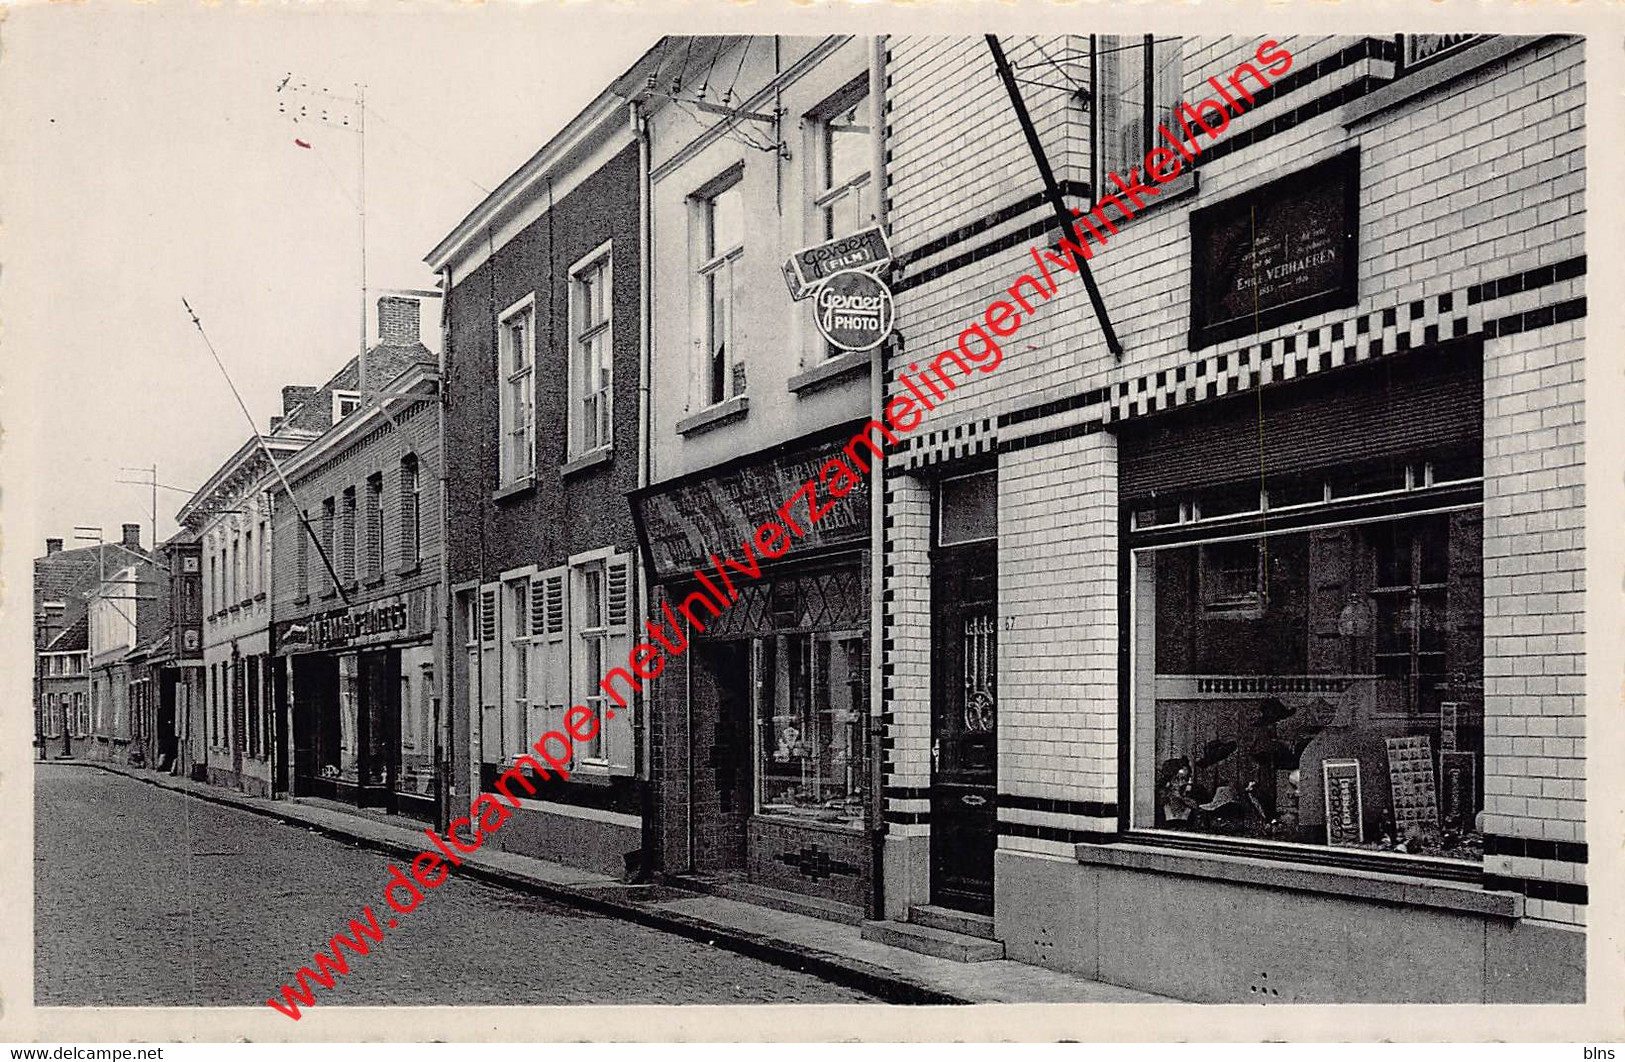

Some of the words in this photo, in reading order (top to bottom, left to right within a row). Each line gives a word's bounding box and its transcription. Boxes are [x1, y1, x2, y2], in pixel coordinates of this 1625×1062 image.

[803, 231, 880, 279] Gevaert
[1266, 247, 1336, 281] VERHAEREN
[820, 288, 888, 333] Gevaert
[835, 316, 878, 330] PHOTO
[1005, 615, 1015, 631] 67
